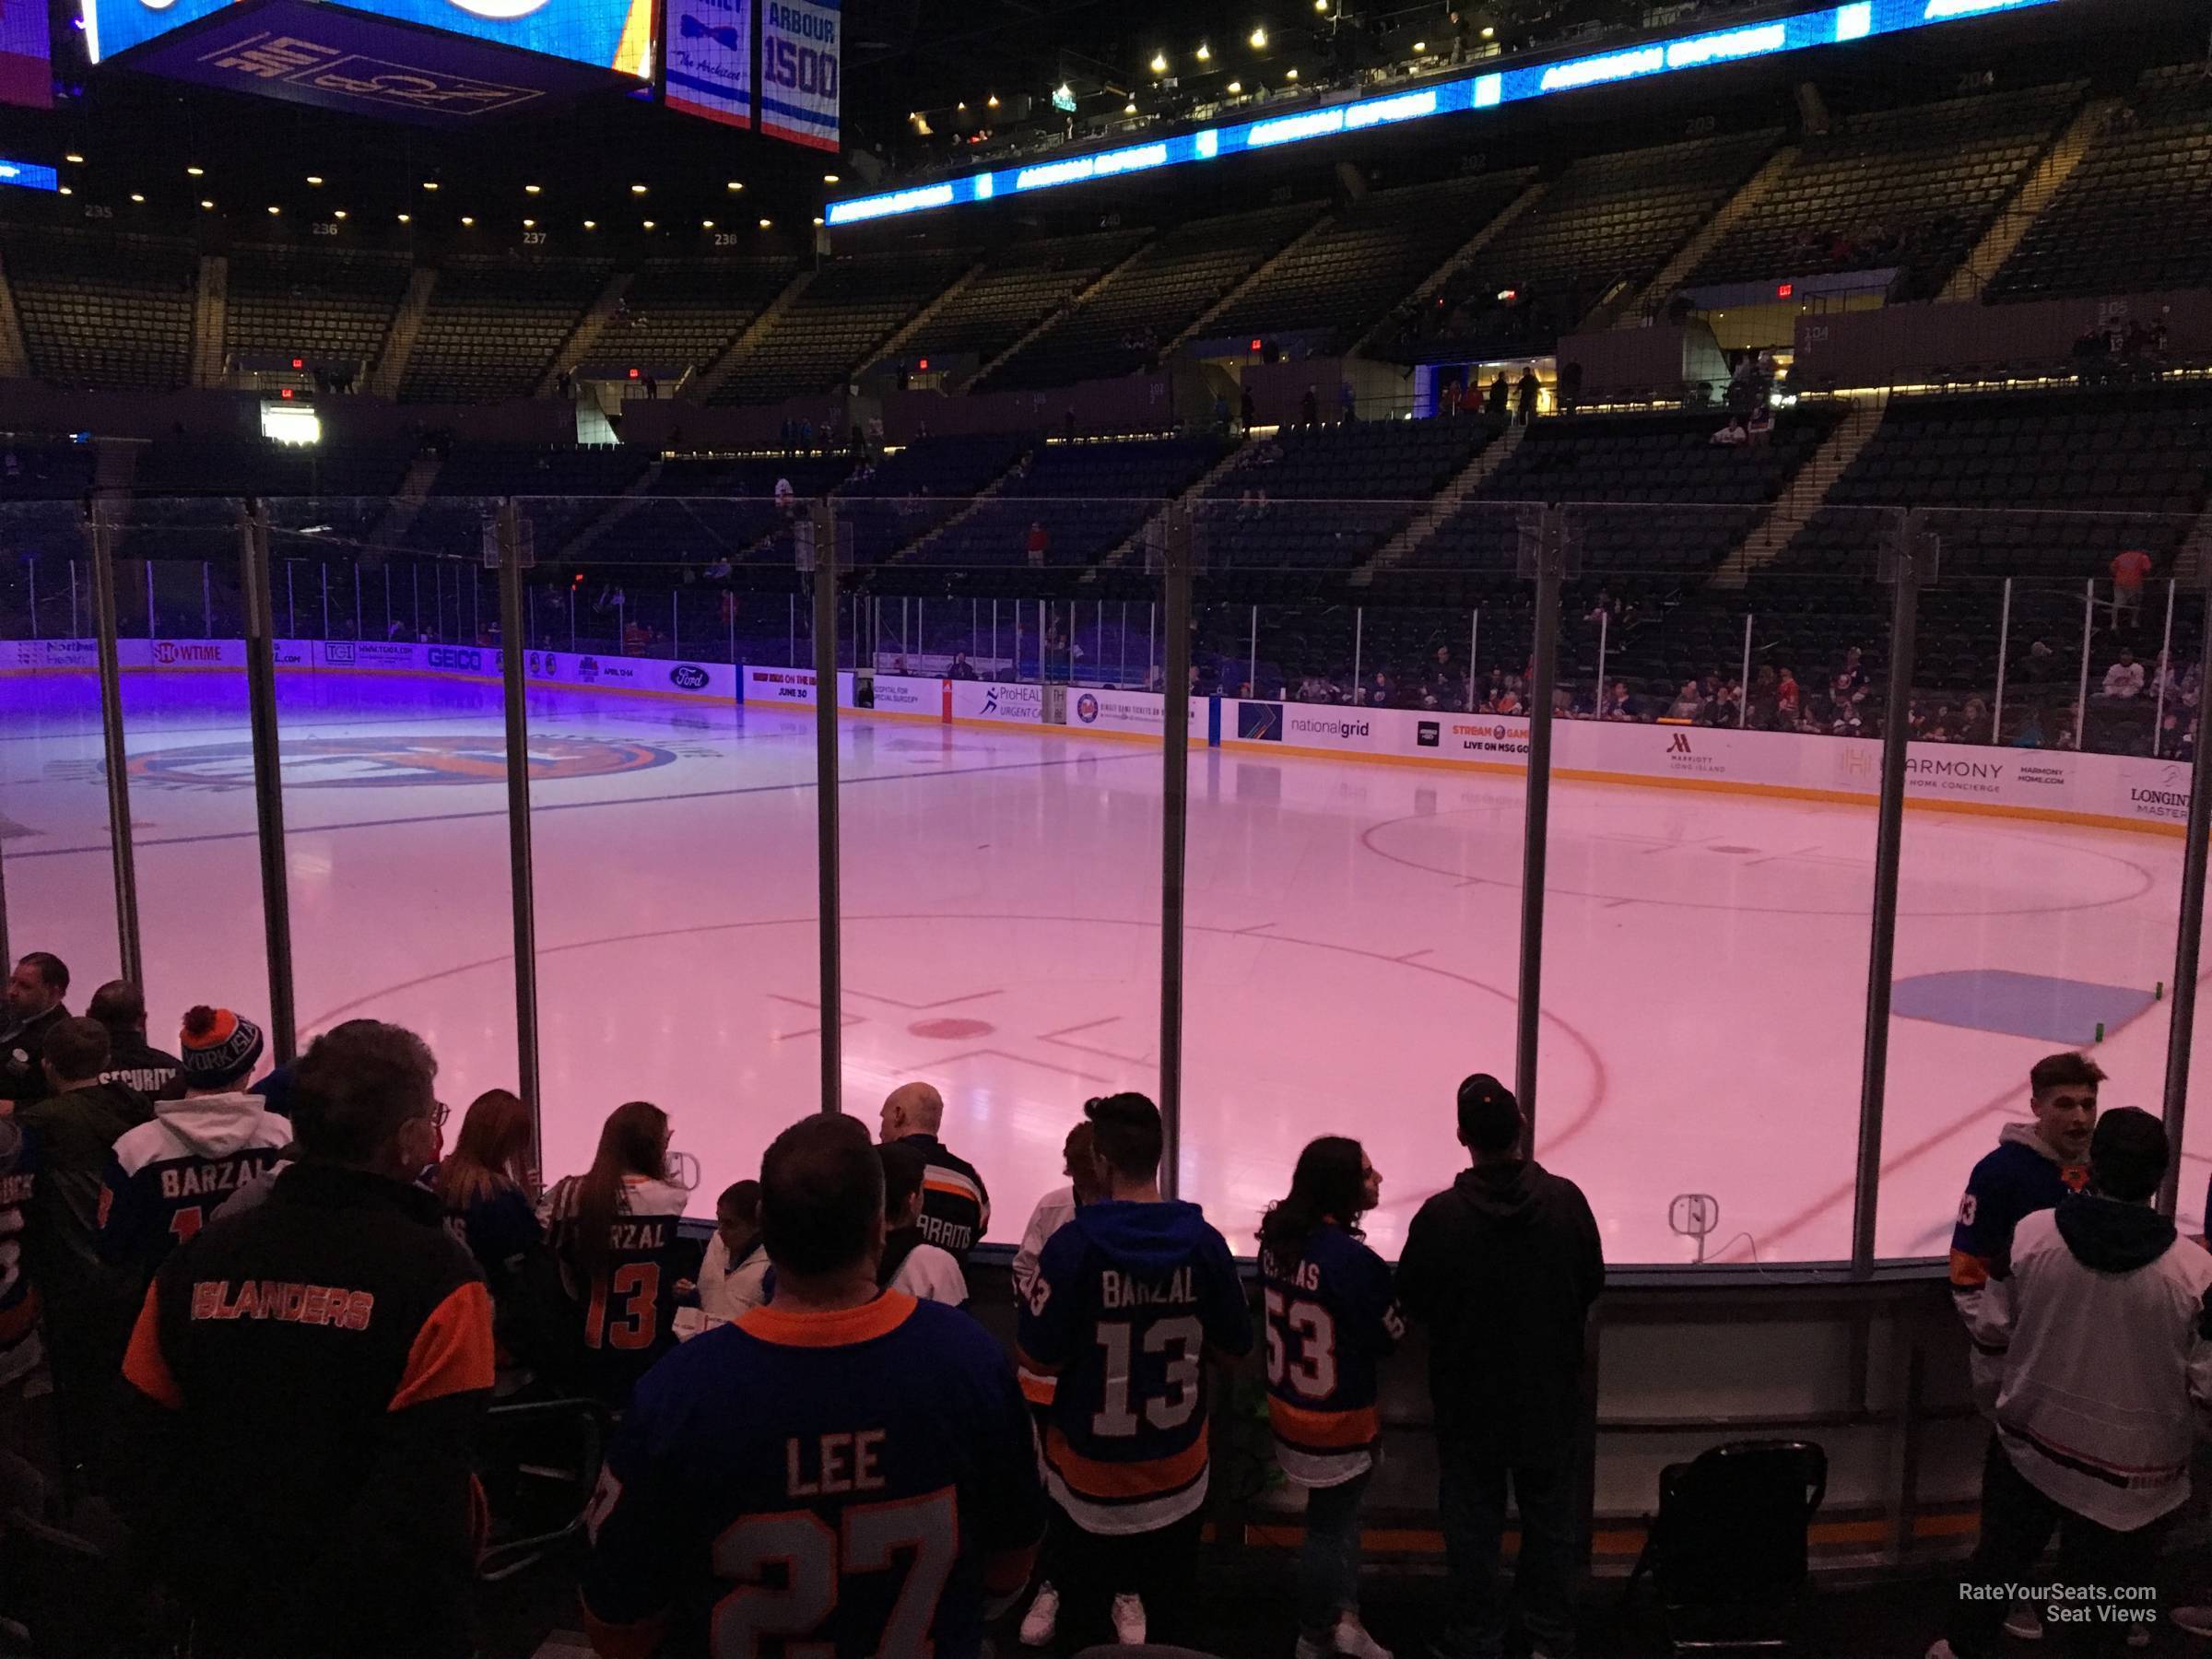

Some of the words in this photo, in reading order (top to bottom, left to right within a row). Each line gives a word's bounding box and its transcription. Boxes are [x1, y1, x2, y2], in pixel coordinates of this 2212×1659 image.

[769, 2, 835, 43] ARBOUR
[764, 35, 839, 100] 1500
[312, 222, 338, 236] 236
[522, 231, 547, 244] 237
[150, 641, 219, 664] SHOWTIME
[428, 647, 479, 671] GEICO
[675, 667, 704, 688] Ford
[779, 688, 796, 698] JUNE
[797, 689, 807, 698] 30
[1291, 717, 1370, 738] nationalgrid
[1453, 725, 1492, 737] STREAM
[1464, 740, 1483, 750] LIVE
[1484, 742, 1497, 751] ON
[1498, 744, 1516, 753] MSG
[1942, 782, 2001, 794] CONCIERGE
[1101, 1265, 1198, 1310] BARZAL
[191, 1279, 373, 1332] ISLANDERS
[584, 1261, 663, 1349] 13
[1264, 1285, 1336, 1398] 53
[1090, 1315, 1204, 1437] 13
[785, 1427, 888, 1501] LEE
[711, 1484, 960, 1659] 27
